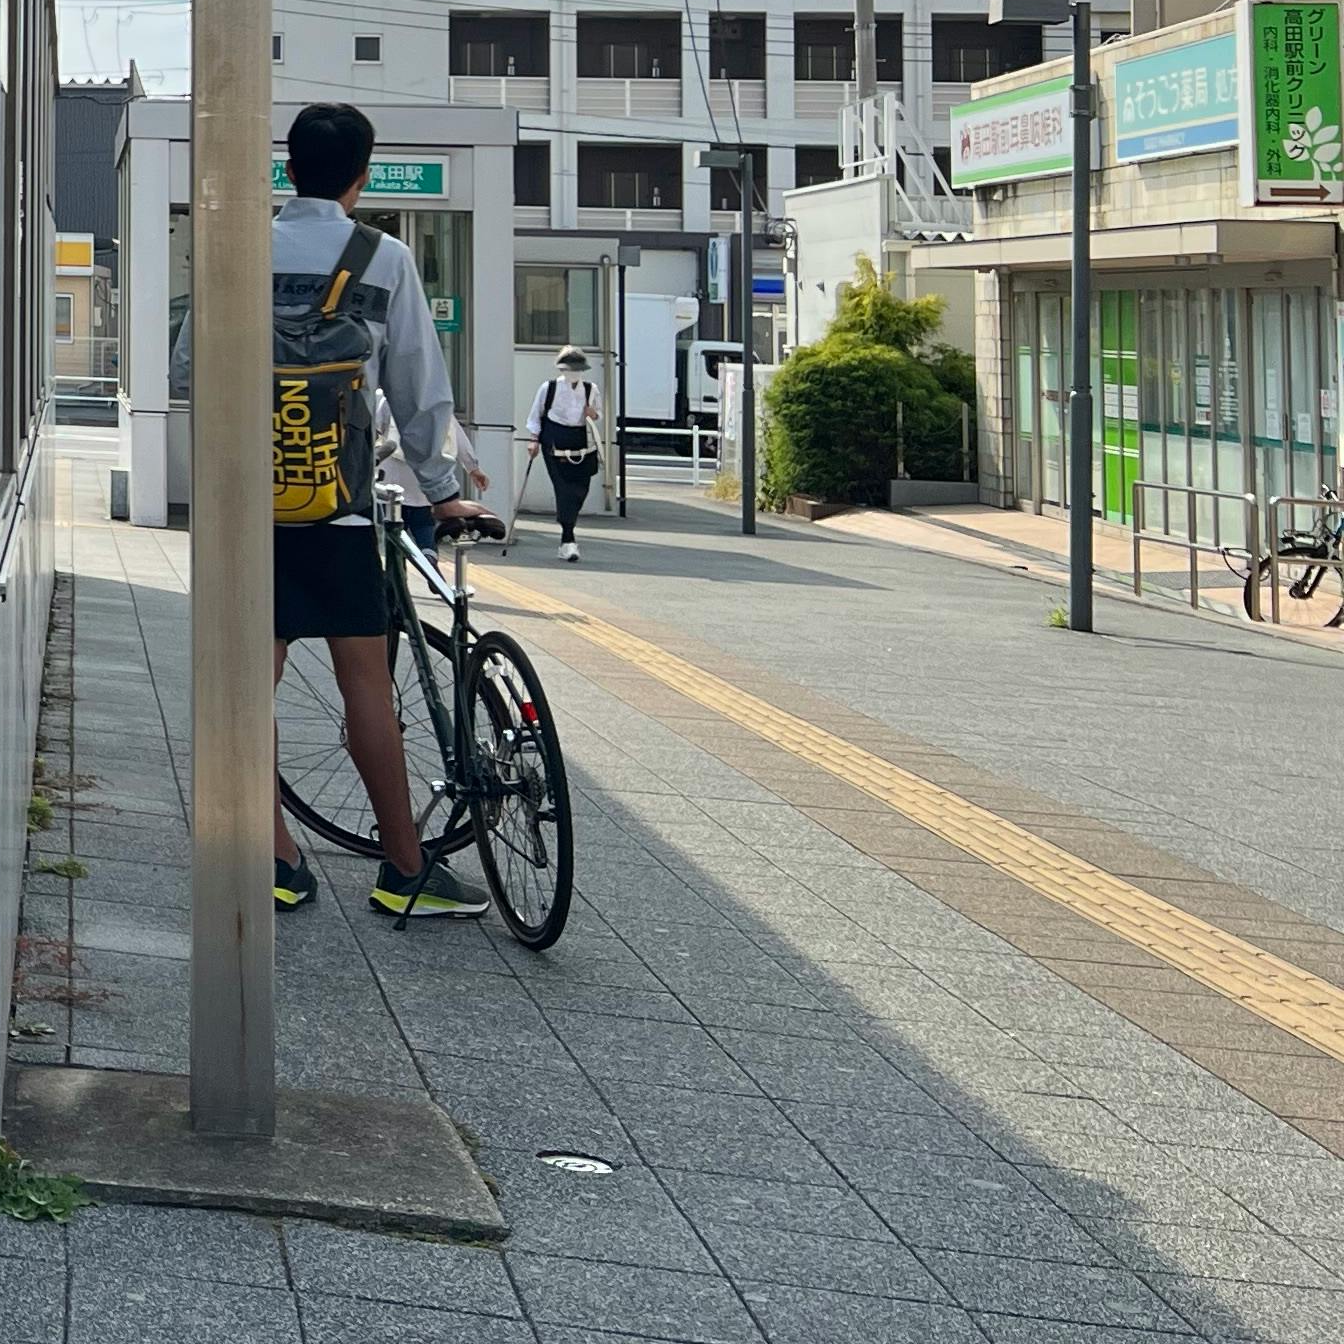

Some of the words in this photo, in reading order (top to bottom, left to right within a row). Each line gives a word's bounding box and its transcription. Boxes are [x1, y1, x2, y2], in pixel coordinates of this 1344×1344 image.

[1308, 8, 1327, 75] グリーン
[1284, 9, 1306, 160] 高田駅前クリニック
[369, 164, 424, 182] 高田駅
[279, 379, 314, 485] NORTH
[313, 422, 339, 485] THE
